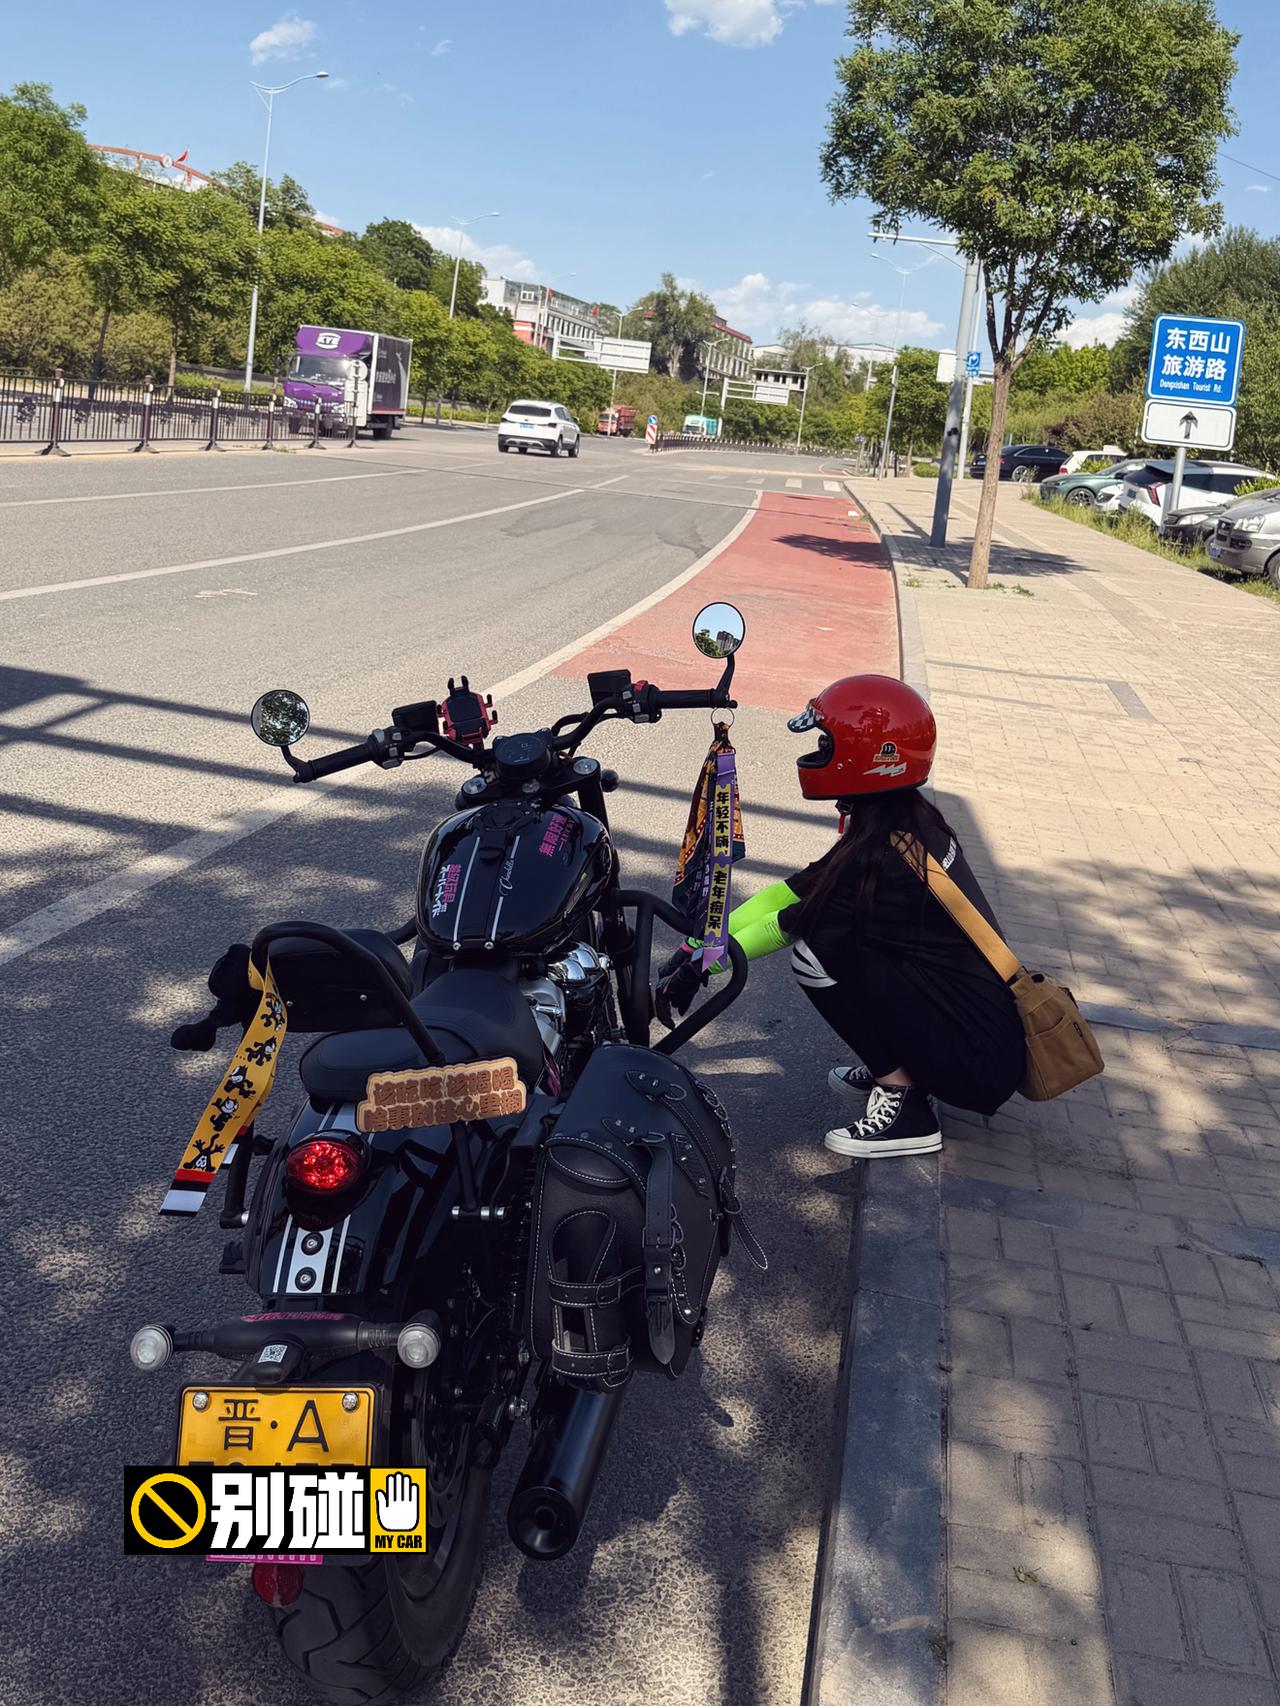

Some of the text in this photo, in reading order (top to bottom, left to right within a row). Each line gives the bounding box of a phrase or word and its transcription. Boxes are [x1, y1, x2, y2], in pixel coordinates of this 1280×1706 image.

[1165, 328, 1231, 354] 东西山
[1161, 354, 1227, 381] 旅游路
[1193, 381, 1210, 392] Tourist
[1213, 384, 1223, 394] Rd.
[707, 871, 728, 930] 老年痴呆
